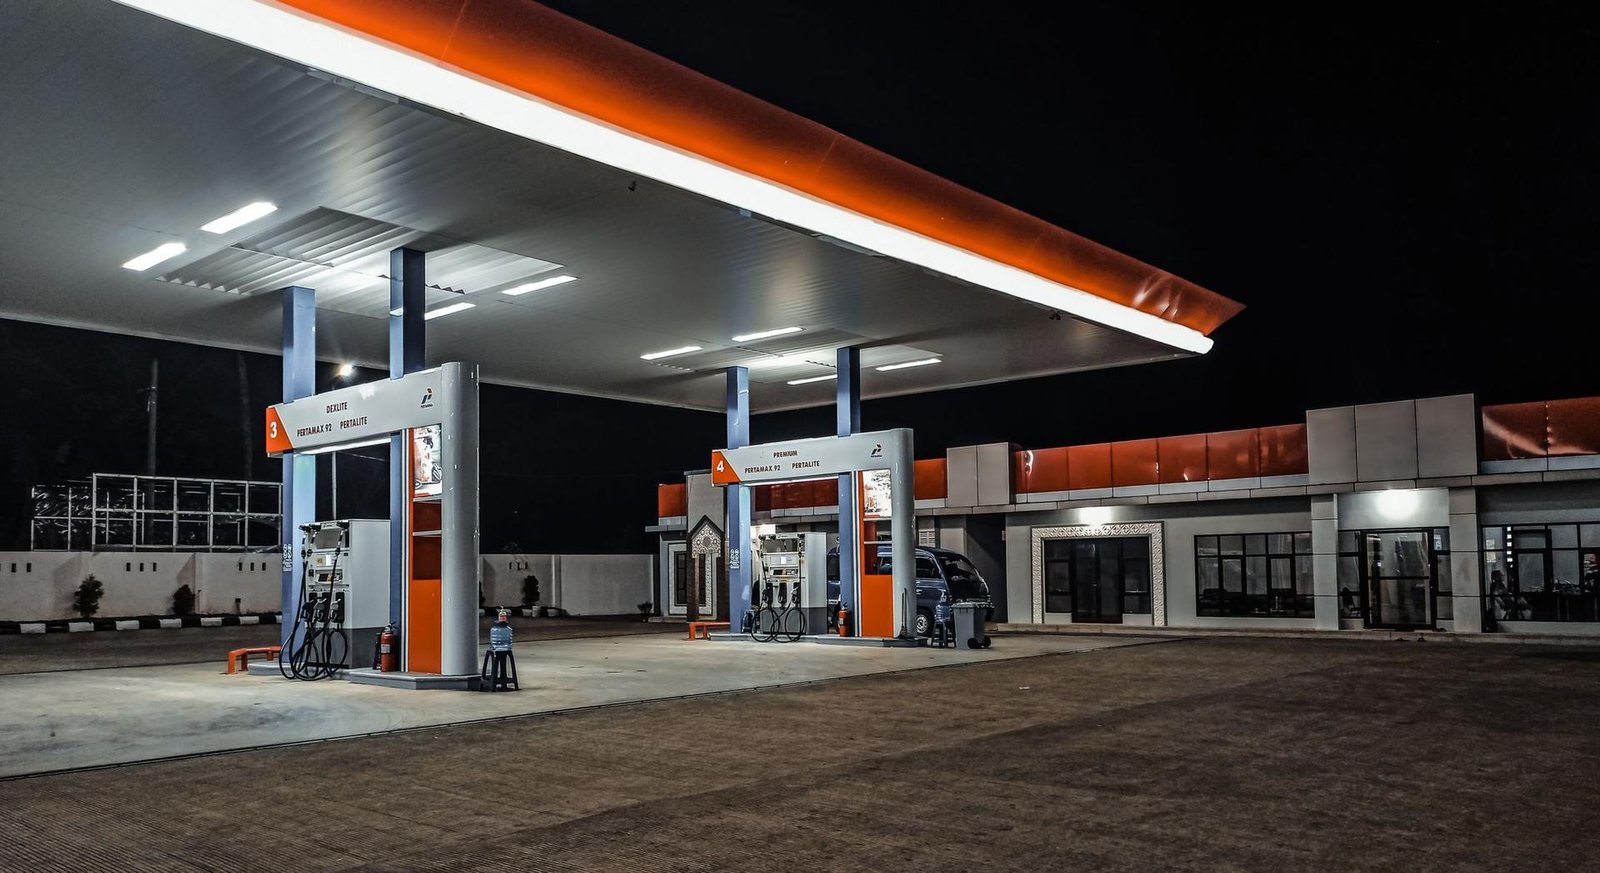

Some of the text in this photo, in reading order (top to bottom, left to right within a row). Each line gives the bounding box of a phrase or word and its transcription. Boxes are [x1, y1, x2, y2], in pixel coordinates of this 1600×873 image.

[326, 402, 348, 414] DEXLITE
[270, 421, 278, 439] 3
[297, 416, 368, 437] PERTAMAX 92 PERTALITE
[773, 450, 798, 458] PREMIUM
[716, 460, 725, 473] 4
[744, 465, 773, 474] PERTAMAX
[791, 460, 820, 469] PERTALITE
